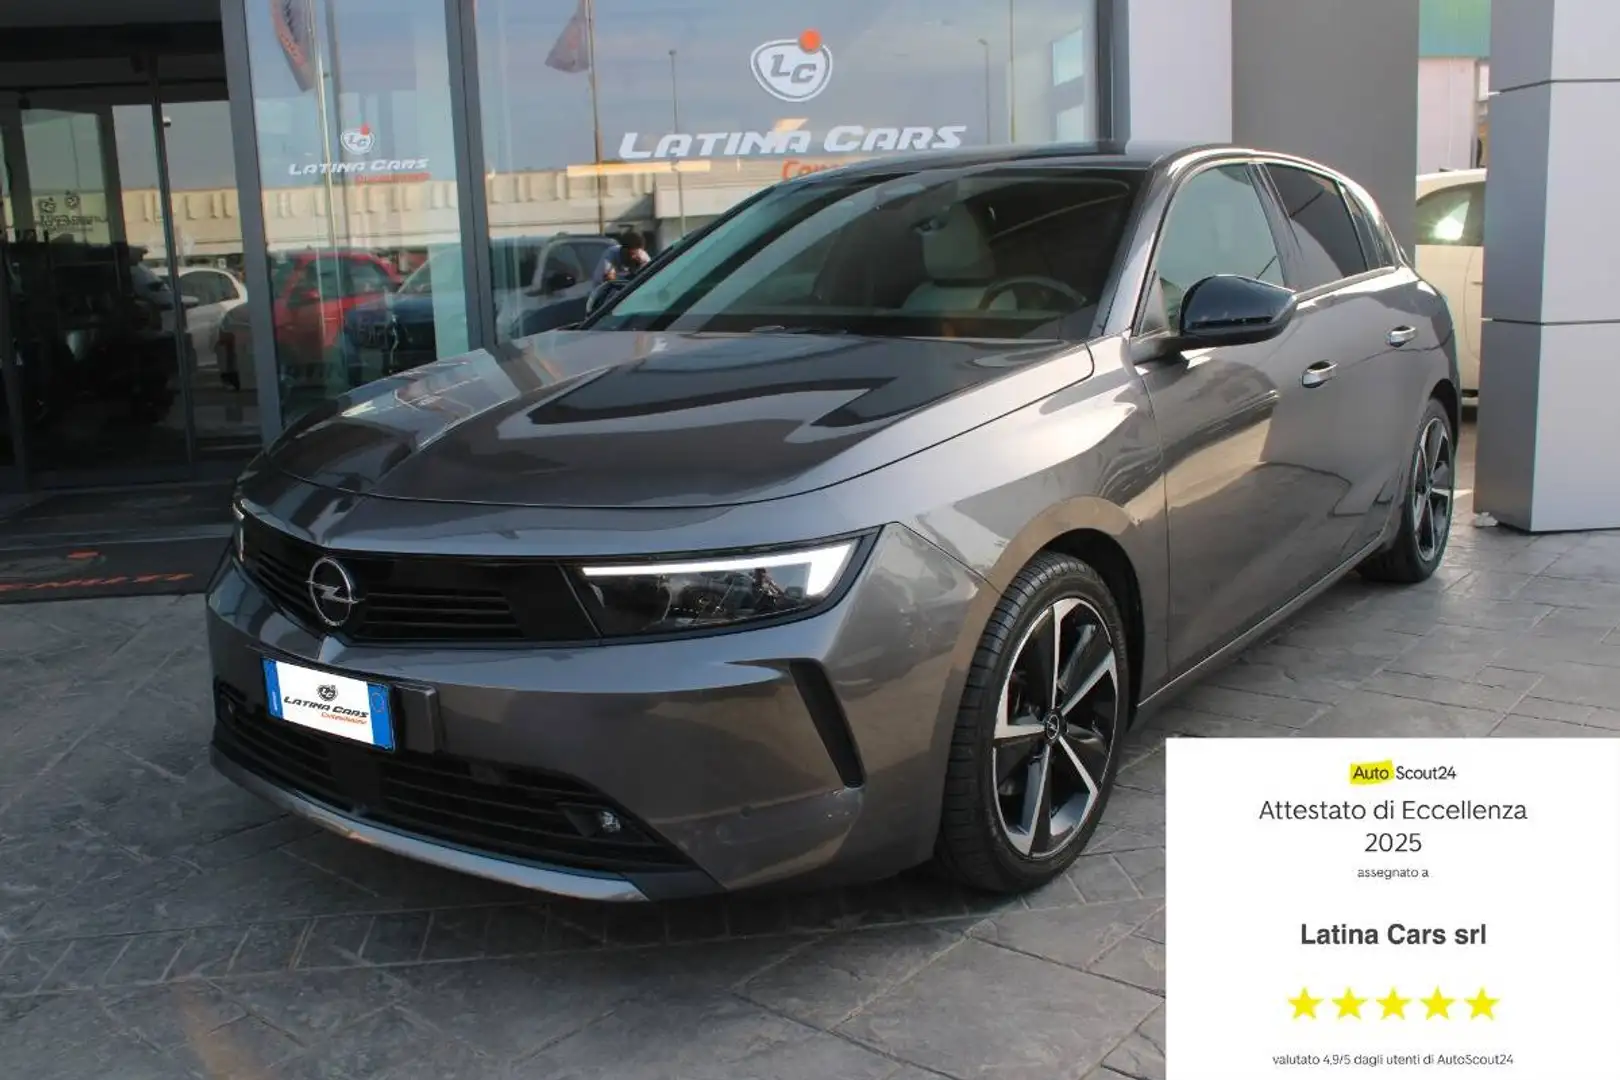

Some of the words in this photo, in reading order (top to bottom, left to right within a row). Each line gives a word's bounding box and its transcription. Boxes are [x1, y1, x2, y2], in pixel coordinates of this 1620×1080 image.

[770, 54, 817, 84] LC
[618, 130, 812, 159] LATINA
[823, 125, 967, 152] CARS
[288, 161, 367, 176] LATINA
[370, 158, 430, 171] CARS
[283, 696, 331, 711] LATINA
[332, 705, 369, 718] CARS
